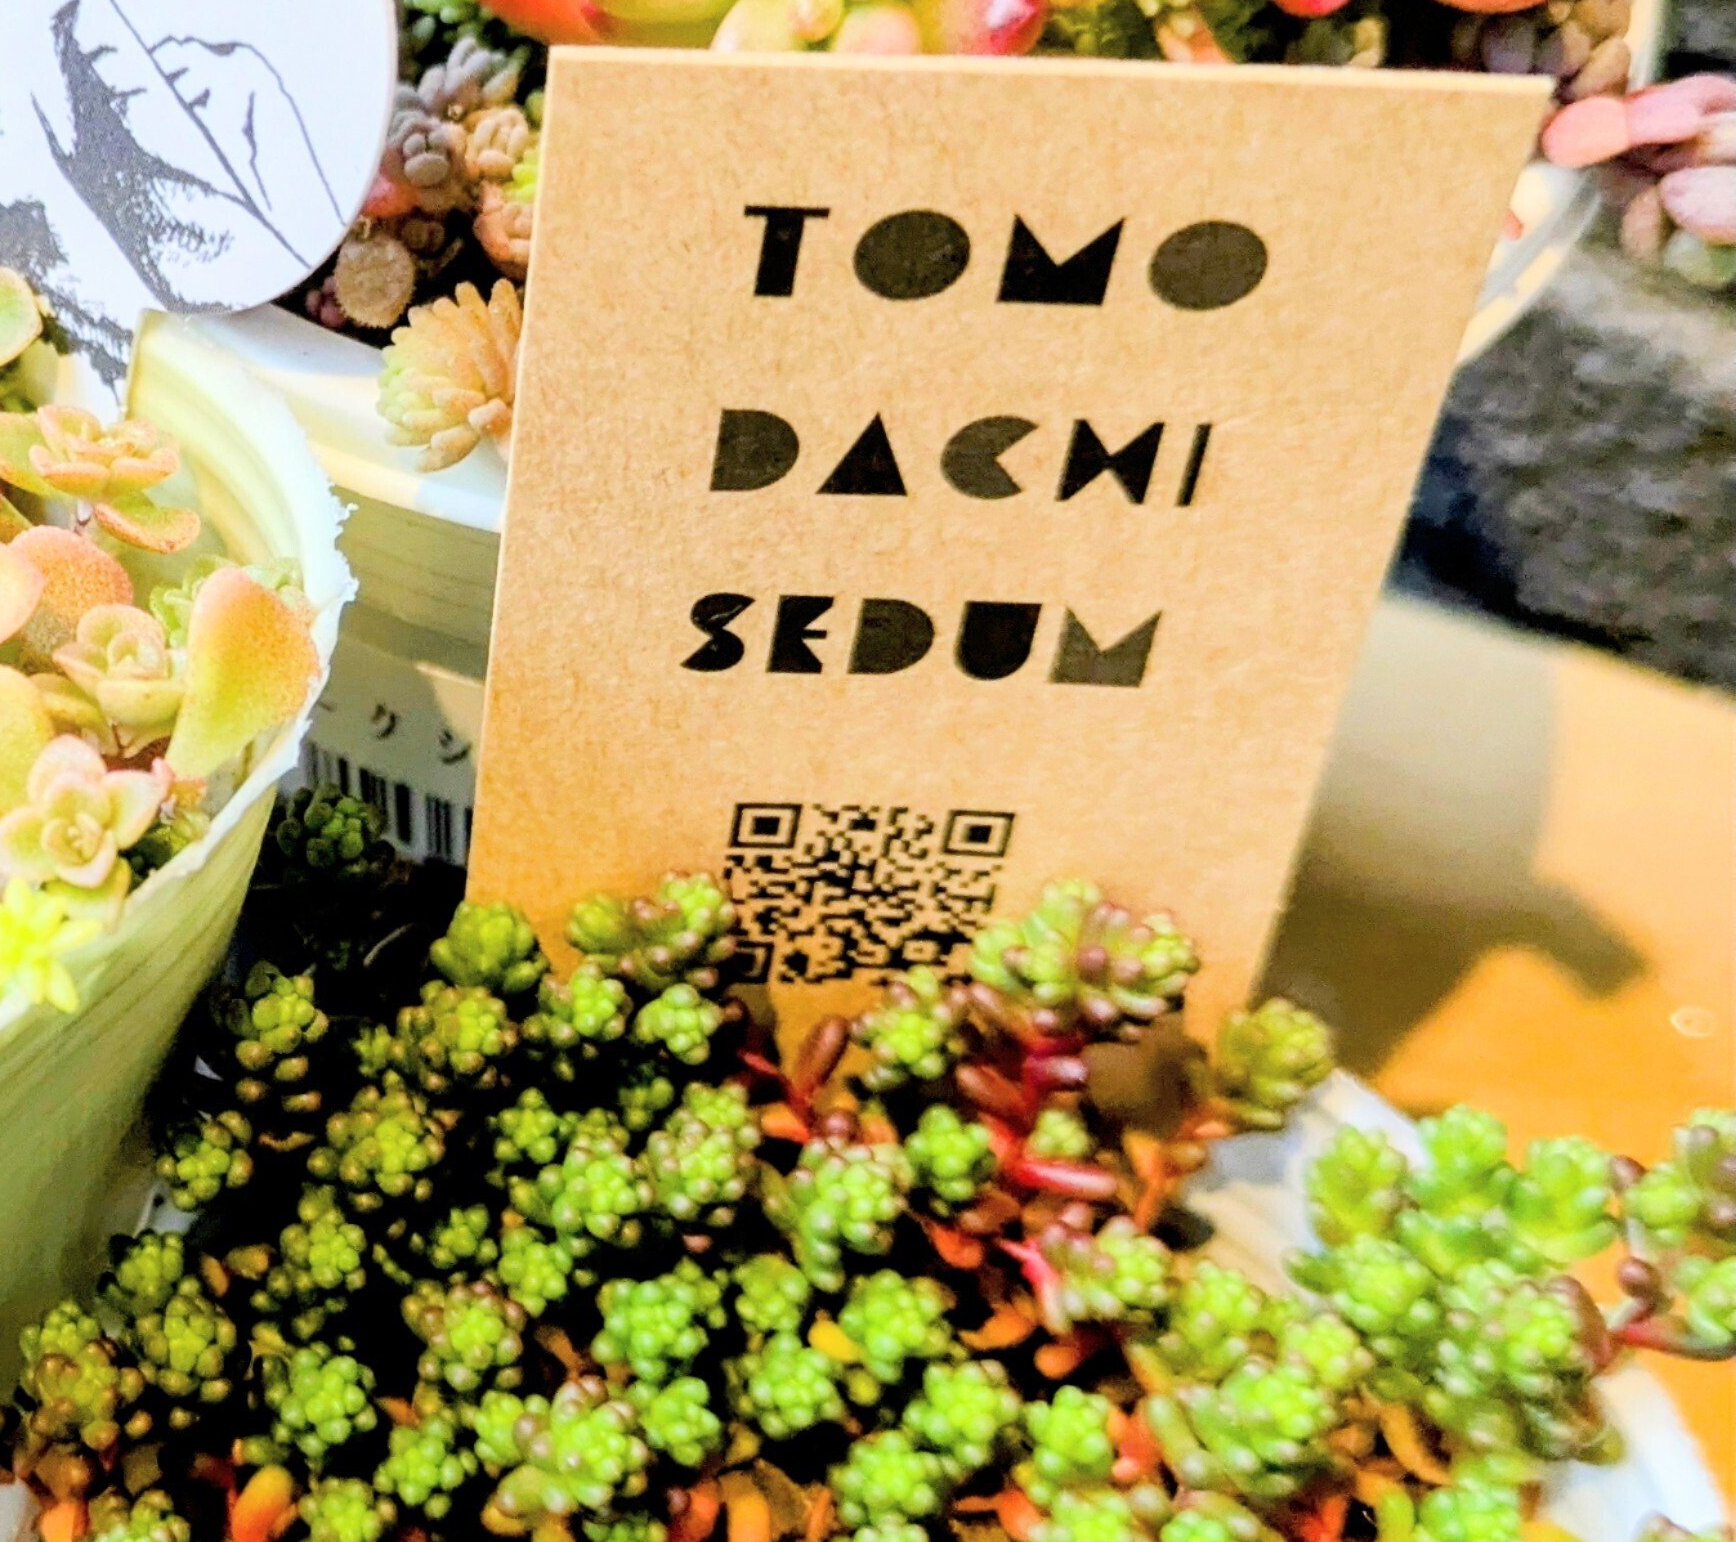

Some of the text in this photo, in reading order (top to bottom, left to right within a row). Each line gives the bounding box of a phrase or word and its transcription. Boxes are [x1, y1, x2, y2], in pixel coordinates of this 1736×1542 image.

[743, 204, 1268, 312] TOMO
[709, 408, 1214, 508] DACHI
[680, 592, 1163, 688] SEDUM
